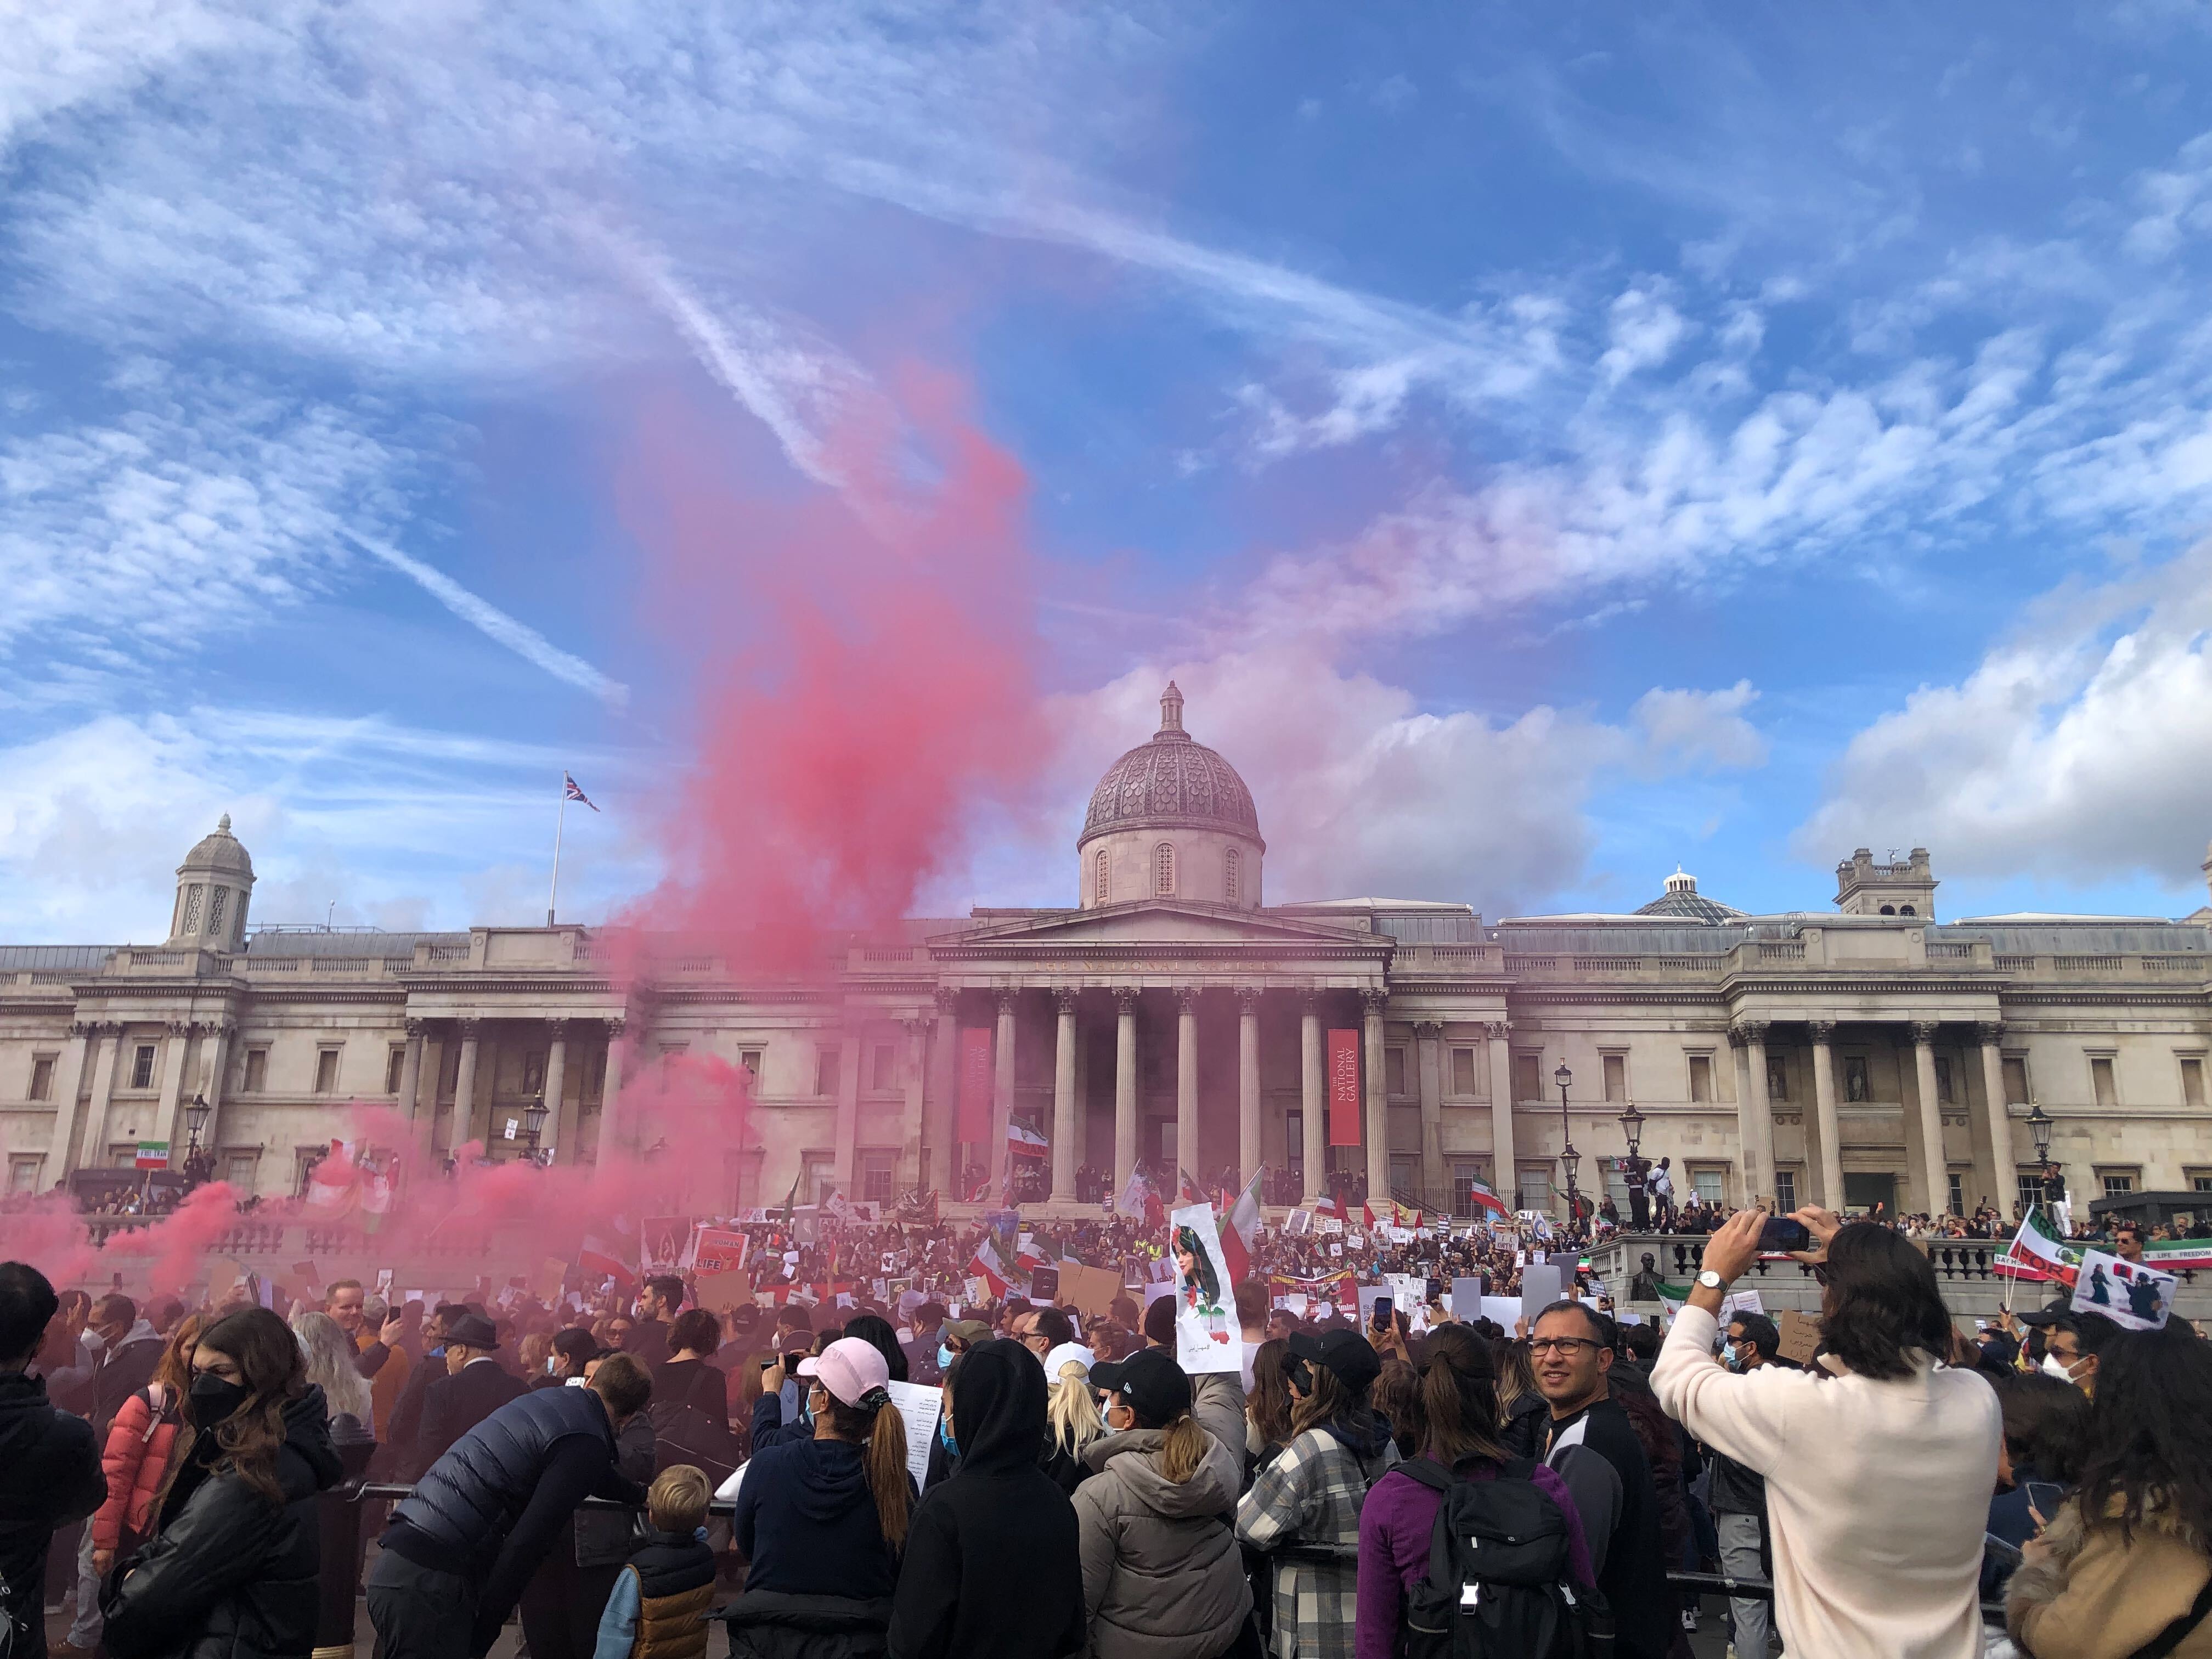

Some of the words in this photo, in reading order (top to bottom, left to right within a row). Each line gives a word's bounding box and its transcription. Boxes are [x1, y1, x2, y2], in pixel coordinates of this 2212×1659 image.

[1032, 961, 1068, 971] THE
[1083, 961, 1180, 971] NATIONAL
[1195, 961, 1282, 970] GALLERY
[1337, 1047, 1345, 1101] NATIONAL
[1346, 1047, 1356, 1102] GALLERY
[696, 1258, 720, 1269] LIFE
